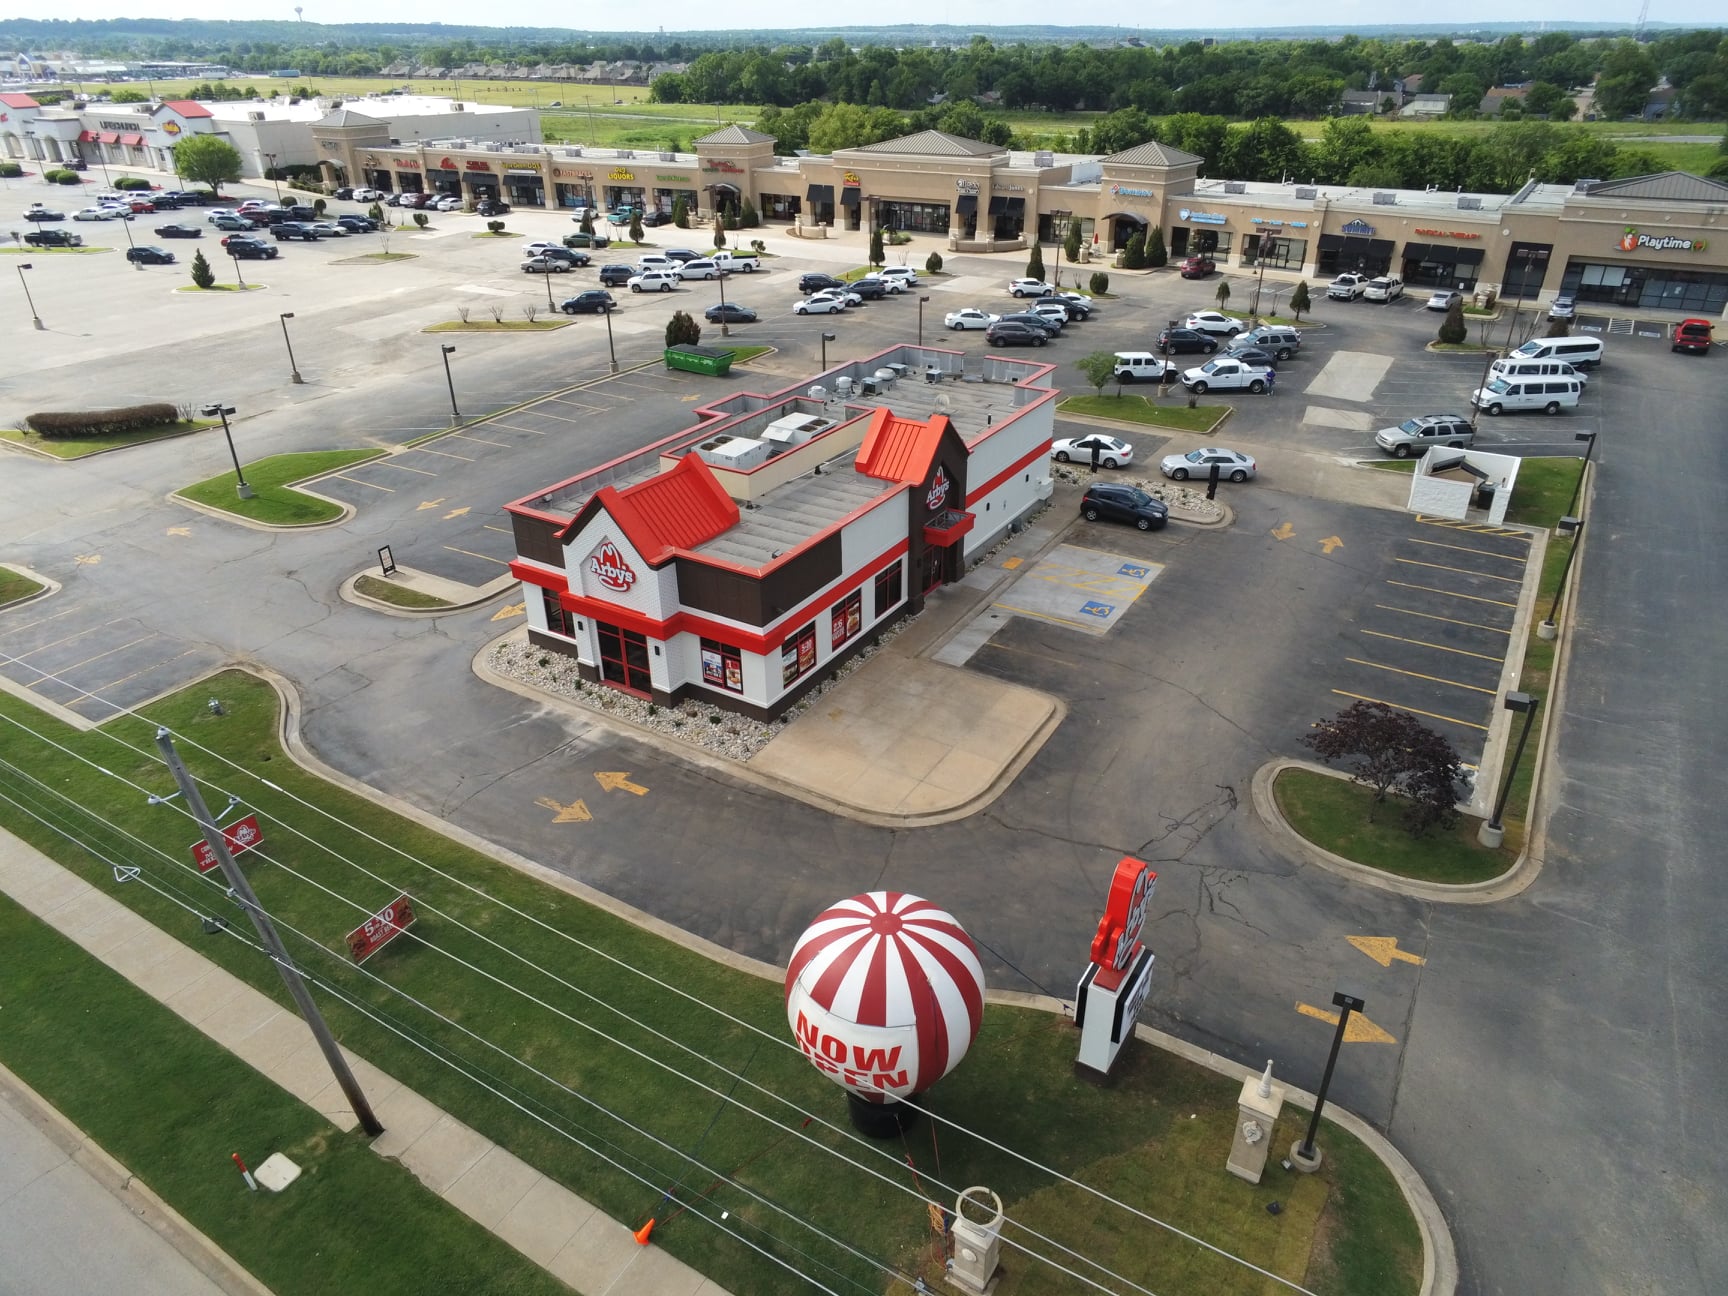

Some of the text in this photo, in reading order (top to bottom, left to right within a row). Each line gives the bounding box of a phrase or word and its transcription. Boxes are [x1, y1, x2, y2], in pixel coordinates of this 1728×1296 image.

[607, 172, 634, 180] LIQUORS
[1637, 234, 1692, 250] Playtime
[591, 557, 633, 583] Arby's
[364, 921, 375, 937] 5
[796, 1009, 902, 1072] NOW
